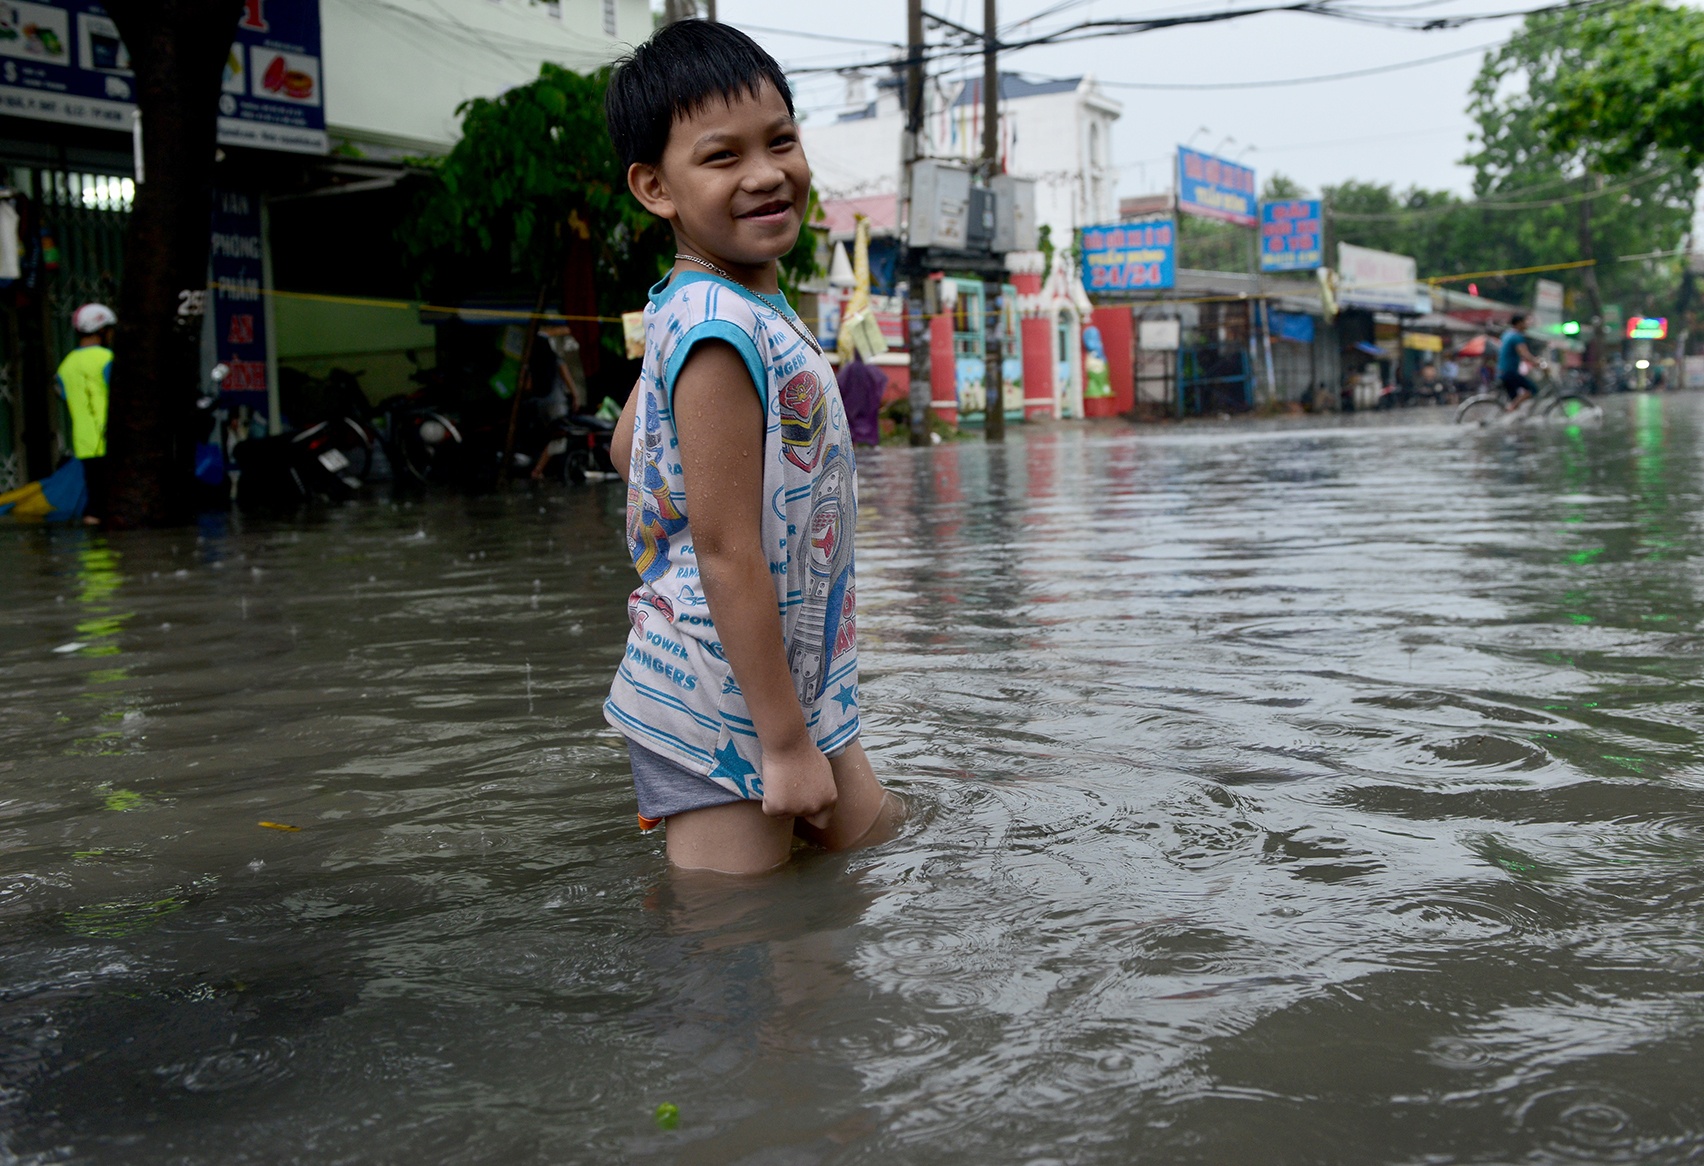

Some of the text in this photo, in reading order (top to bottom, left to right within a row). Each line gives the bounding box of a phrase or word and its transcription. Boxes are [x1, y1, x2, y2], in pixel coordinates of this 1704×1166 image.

[1091, 263, 1161, 287] 24/24
[774, 352, 807, 380] NGERS
[626, 643, 698, 692] RANGERS
